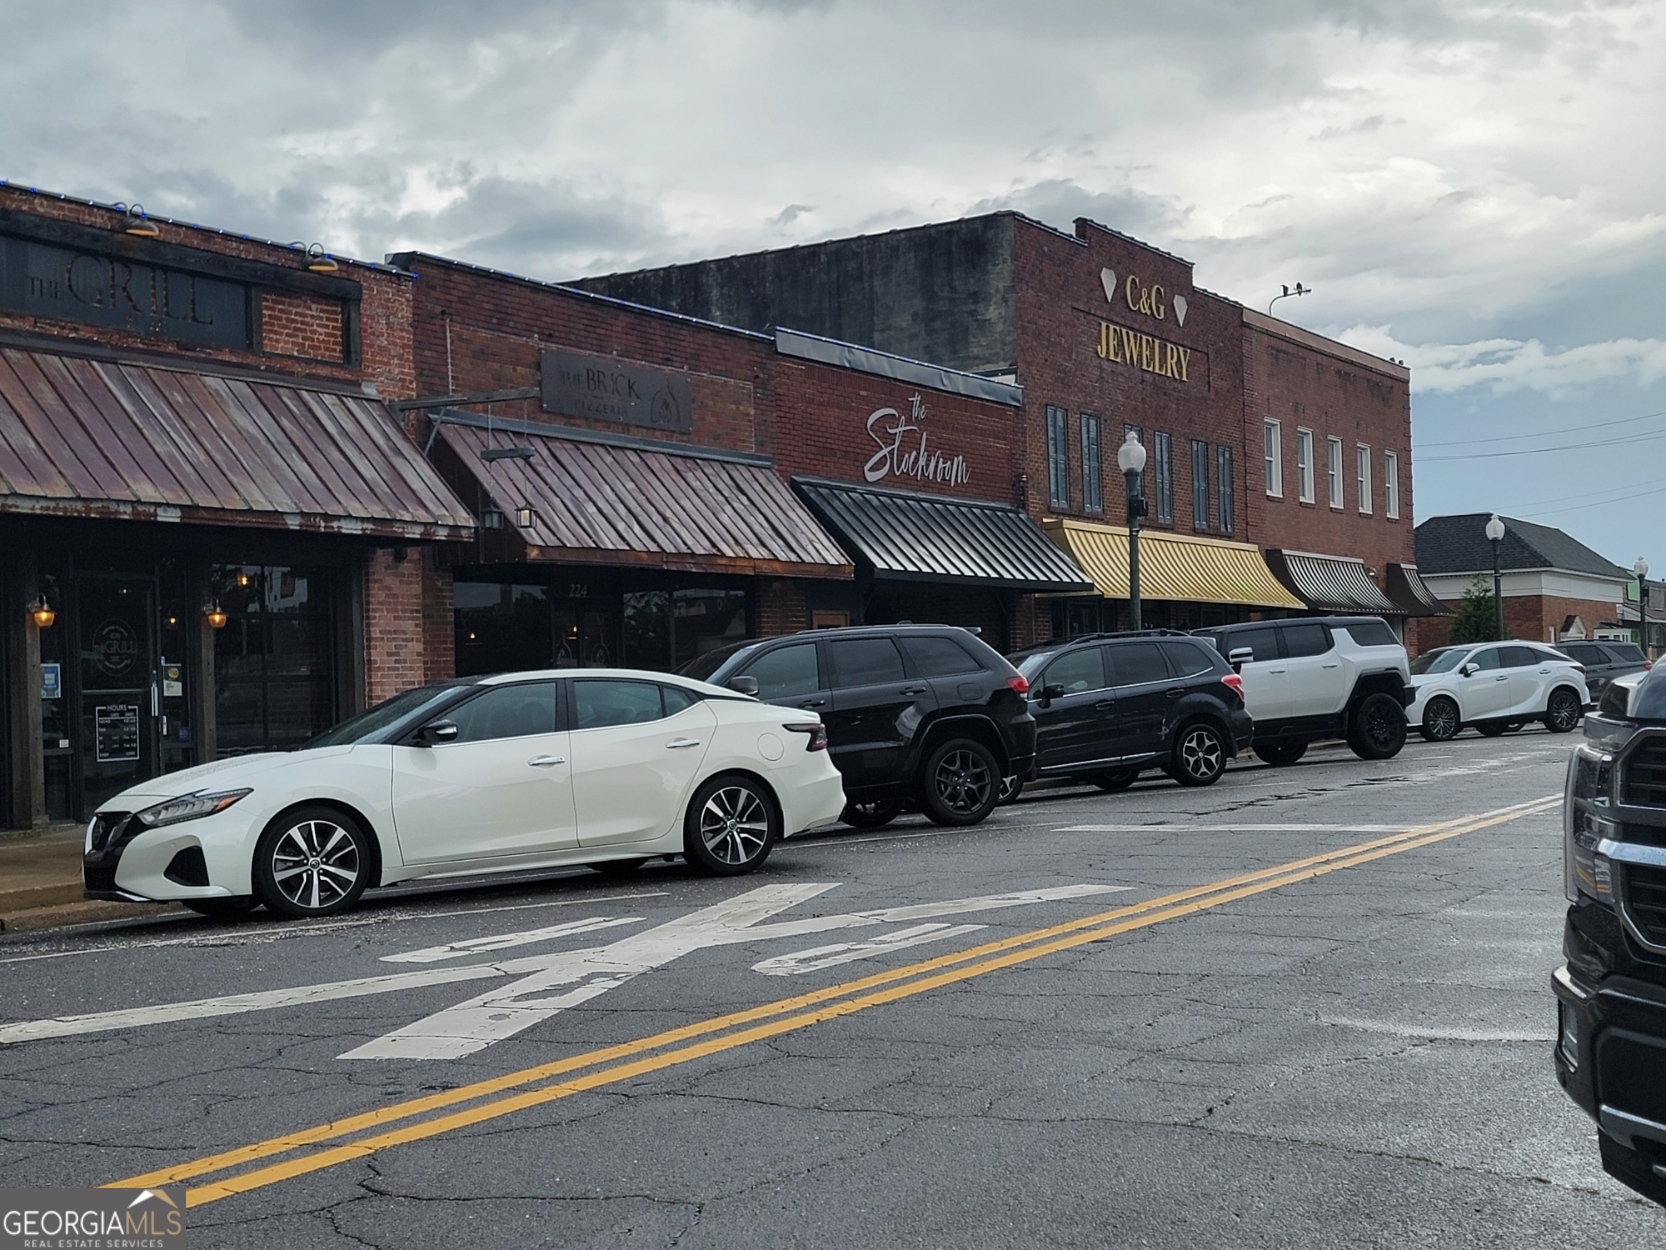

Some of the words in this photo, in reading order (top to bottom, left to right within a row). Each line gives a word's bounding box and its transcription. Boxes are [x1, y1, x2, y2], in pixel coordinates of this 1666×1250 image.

[66, 254, 214, 326] GRILL
[1126, 274, 1165, 320] C&G
[1097, 320, 1191, 382] JEWELRY
[586, 367, 641, 400] BRICK
[908, 391, 927, 422] the
[863, 407, 972, 488] Stockroom
[568, 583, 588, 598] 224
[104, 639, 137, 654] GRILL
[106, 704, 127, 712] HOURS
